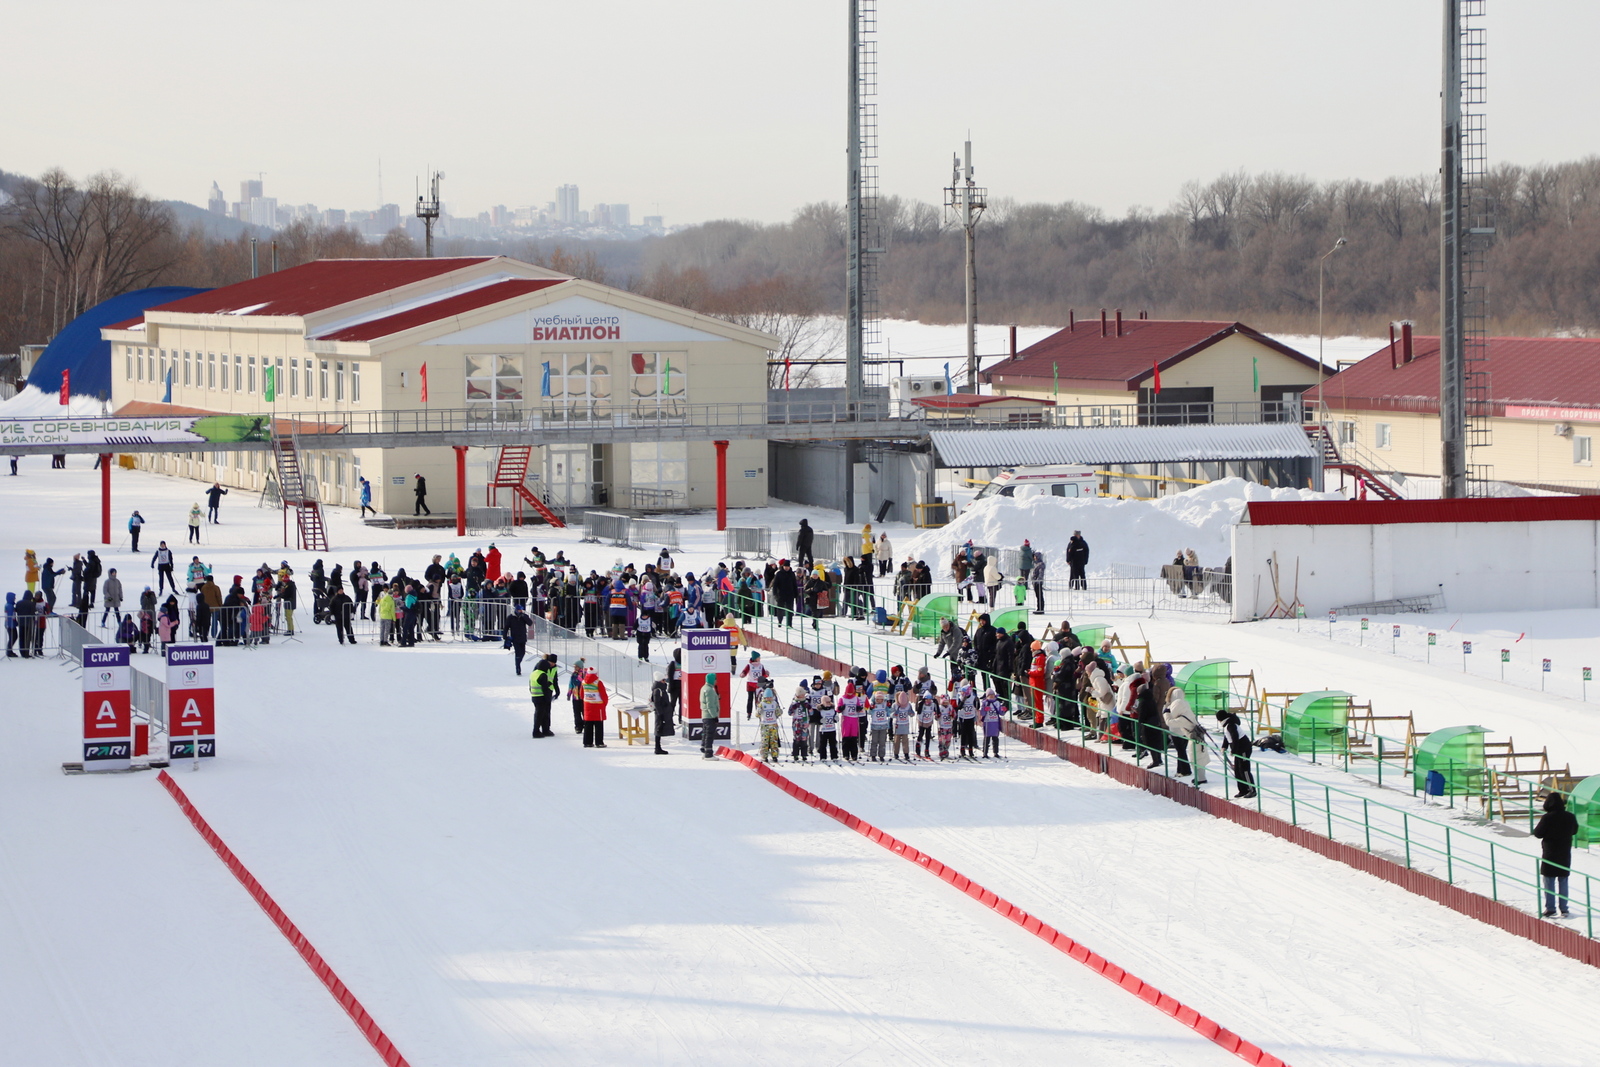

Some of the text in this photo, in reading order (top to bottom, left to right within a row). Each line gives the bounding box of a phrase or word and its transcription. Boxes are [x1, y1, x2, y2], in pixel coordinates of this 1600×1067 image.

[534, 314, 620, 327] учебный центр
[533, 326, 620, 340] БИАТЛОН
[1521, 408, 1600, 420] ПРОКАТ СПОРТИВН
[33, 420, 181, 433] СОРЕВНОВАНИЯ
[3, 434, 69, 444] БИАТЛОНУ
[691, 636, 727, 646] ФИНИШ
[90, 652, 120, 662] СТАРТ
[171, 650, 210, 661] ФИНИШ
[86, 745, 127, 757] PARI
